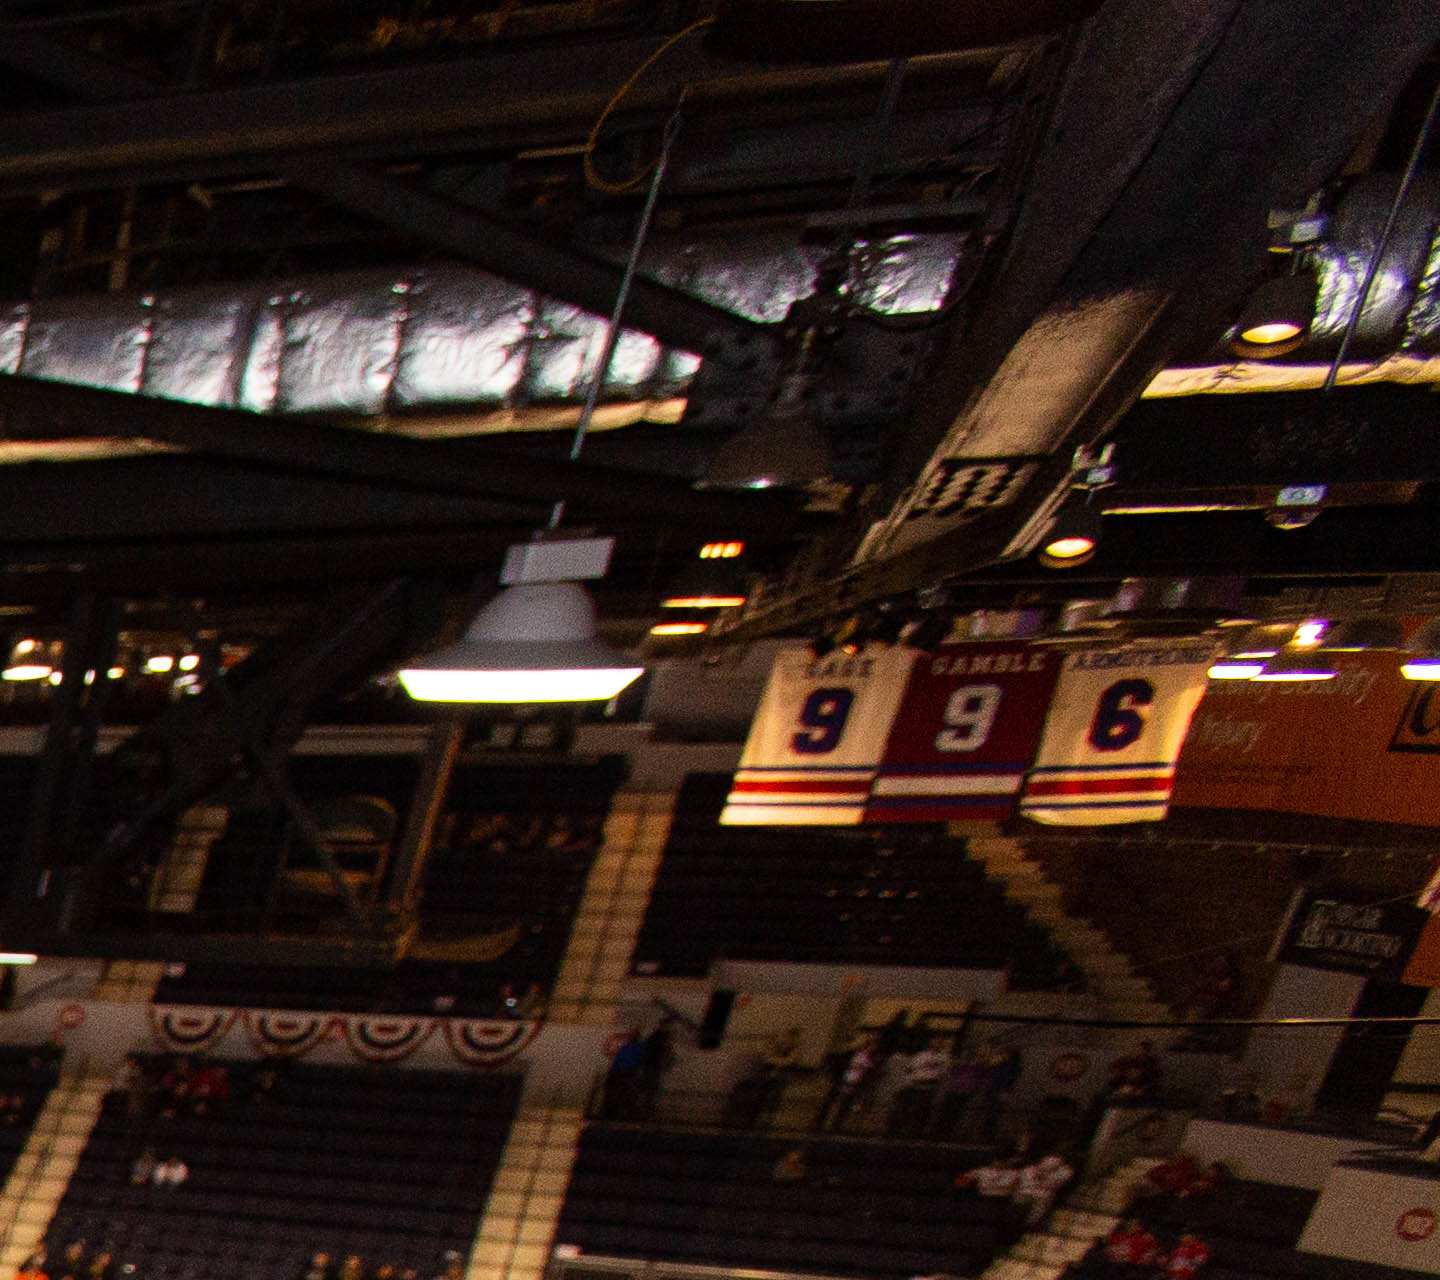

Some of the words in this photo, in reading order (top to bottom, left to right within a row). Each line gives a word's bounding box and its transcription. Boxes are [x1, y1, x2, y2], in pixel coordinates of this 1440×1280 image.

[790, 688, 855, 754] 9
[934, 683, 1002, 752] 9
[1088, 678, 1154, 752] 6
